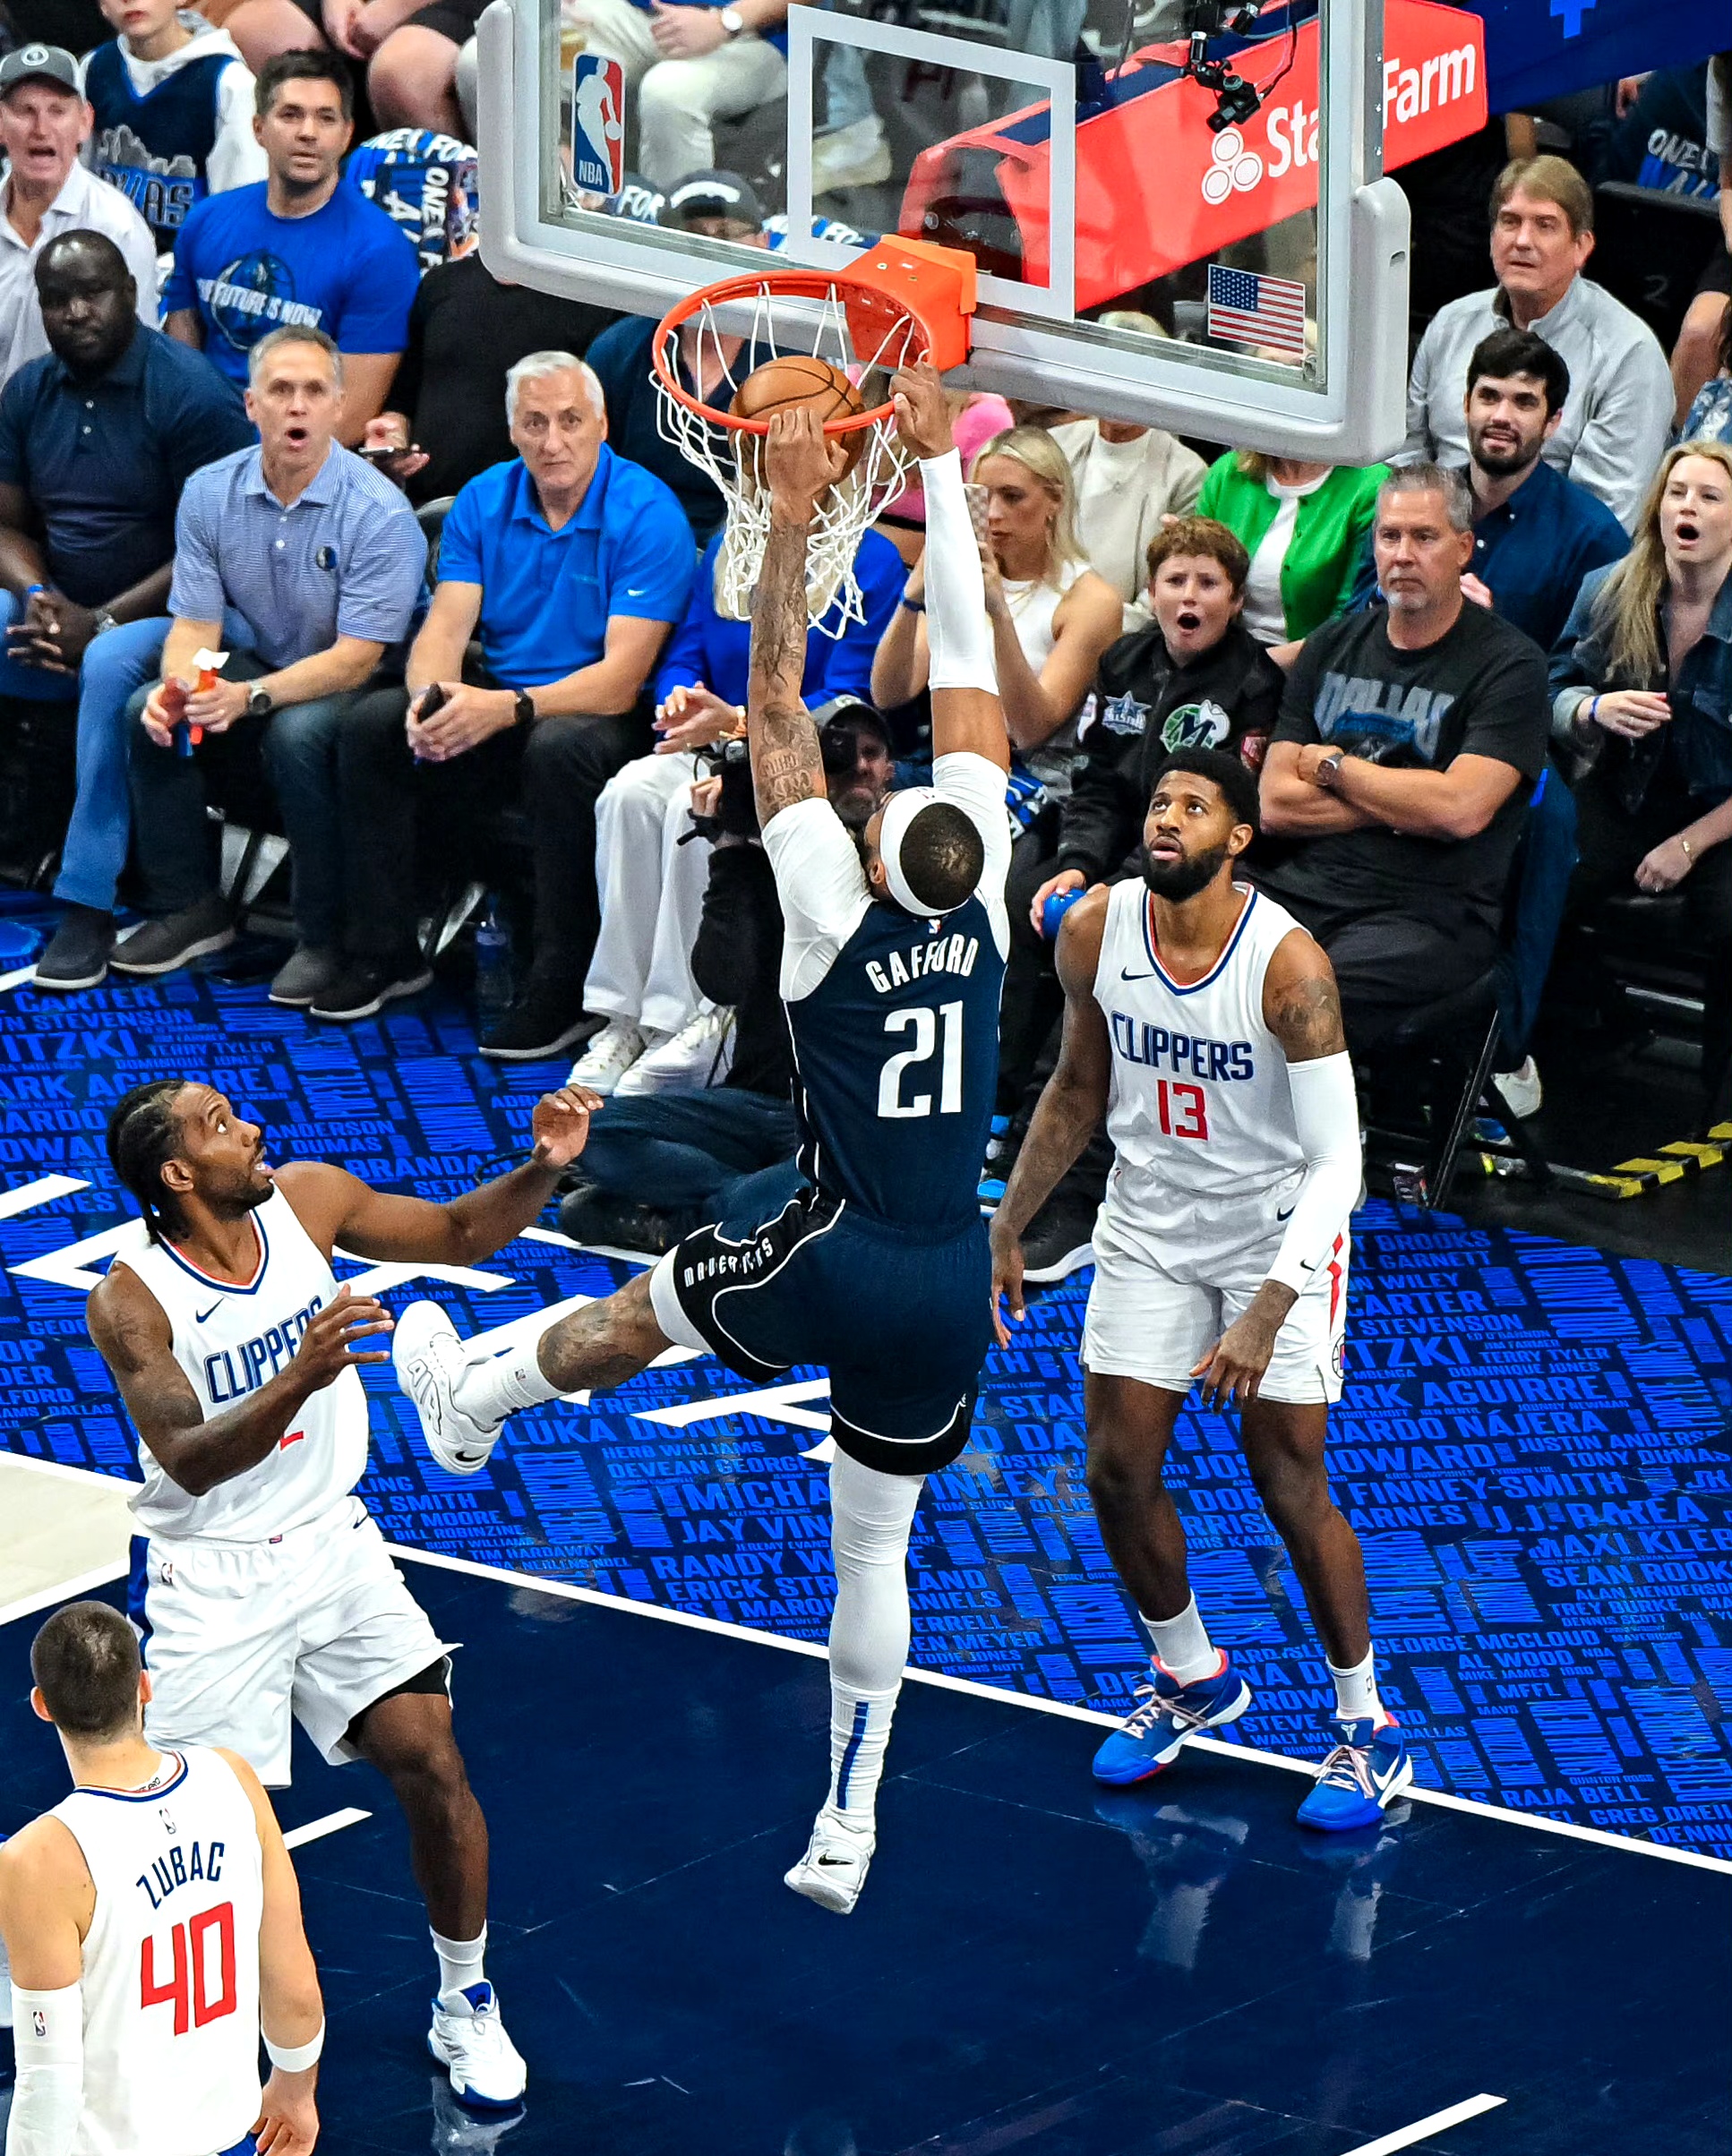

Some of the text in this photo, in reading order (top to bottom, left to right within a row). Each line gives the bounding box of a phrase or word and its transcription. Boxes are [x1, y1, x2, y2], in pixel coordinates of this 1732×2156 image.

[1383, 43, 1476, 129] Farm
[579, 159, 604, 186] NBA
[865, 933, 979, 993] GAFFORD
[33, 1008, 194, 1029] STEVENSON
[1110, 1010, 1254, 1081] CLIPPERS
[878, 999, 964, 1118] 21
[1157, 1079, 1209, 1141] 13
[265, 1120, 395, 1139] ANDERSON
[292, 1137, 382, 1154] DUMAS
[1374, 1230, 1491, 1252] BROOKS
[1378, 1250, 1491, 1270] GARNETT
[1377, 1272, 1459, 1290] WILEY
[1523, 1265, 1642, 1339] ROLANDO
[1358, 1313, 1524, 1336] STEVENSON
[1479, 1347, 1610, 1364] TERRY TYLER
[1616, 1340, 1702, 1379] JONES
[1447, 1362, 1601, 1379] DOMINIQUE JONES
[1422, 1375, 1608, 1407] AGUIRRE
[504, 1416, 618, 1446] LUKA
[1453, 1409, 1610, 1438] NÁJERA
[602, 1441, 766, 1459] HERB WILLIAMS
[1519, 1435, 1603, 1453] JUSTIN
[606, 1456, 814, 1477] DEVEAN GEORGE
[1562, 1451, 1629, 1467] TONY
[1348, 1471, 1629, 1506] FINNEY-SMITH
[390, 1493, 477, 1512] SMITH
[420, 1510, 505, 1527] MOORE
[1493, 1503, 1558, 1533] J.J.
[393, 1525, 526, 1541] BILL ROBINZINE
[682, 1519, 745, 1544] JAY
[1529, 1532, 1632, 1559] MAXI
[649, 1551, 783, 1579] RANDY
[1542, 1565, 1634, 1587] SEAN
[665, 1578, 769, 1602] ERICK
[1575, 1587, 1625, 1601] ALAN
[1045, 1583, 1140, 1640] JACKSON
[1548, 1598, 1682, 1616] TREY BURKE
[1561, 1615, 1618, 1628] DENNIS
[1621, 1613, 1666, 1625] SCOTT
[952, 1631, 1044, 1650] MEYER
[1374, 1629, 1600, 1655] GEORGE MCCLOUD
[916, 1652, 962, 1664] EDDIE
[1459, 1649, 1575, 1670] AL WOOD
[1457, 1668, 1550, 1681] MIKE JAMES
[1496, 1681, 1562, 1698] MFFL
[1240, 1714, 1316, 1732] STEVE
[1526, 1698, 1605, 1735] MEJRI
[1402, 1725, 1468, 1740] DALLAS
[1544, 1736, 1625, 1776] SALAH
[1501, 1788, 1574, 1808] RAJA
[1579, 1784, 1651, 1803] BELL
[1589, 1807, 1658, 1826] GREG
[135, 1841, 226, 1910] ZUBAC
[141, 1901, 237, 2037] 40
